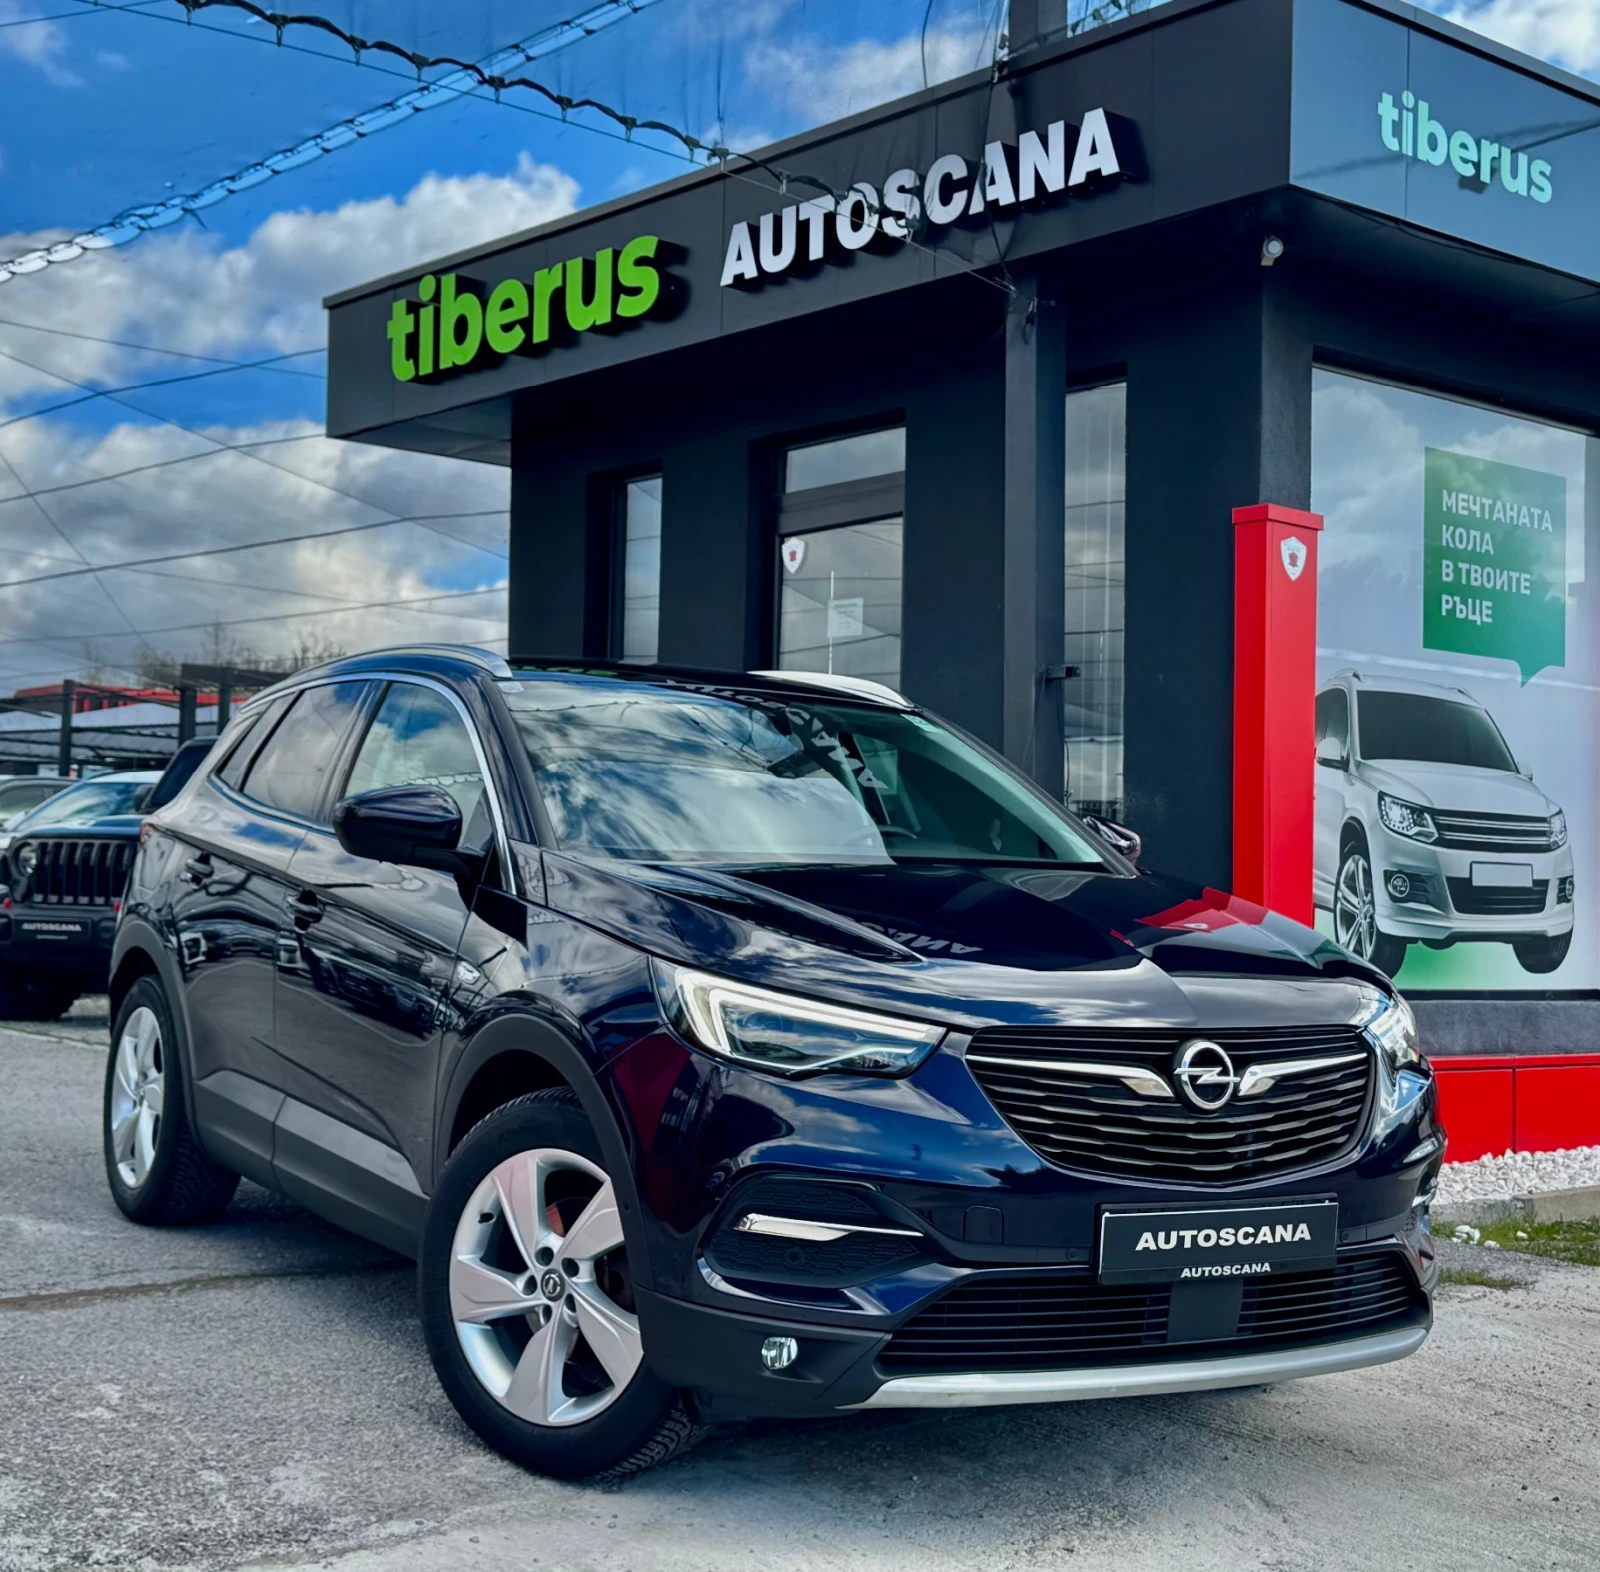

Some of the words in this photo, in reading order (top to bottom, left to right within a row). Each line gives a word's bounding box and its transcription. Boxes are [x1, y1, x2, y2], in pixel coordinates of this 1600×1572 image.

[1377, 90, 1553, 204] tiberus
[719, 107, 1120, 287] AUTOSCANA
[387, 235, 660, 382] tiberus
[1442, 489, 1553, 532] МЕЧТАНАТА
[1442, 524, 1494, 555] КОЛА
[1442, 559, 1454, 583] В
[1458, 562, 1531, 595] ТВОИТЕ
[1441, 594, 1493, 626] РЪЦЕ
[21, 922, 82, 931] AUTOSCANA
[1135, 1223, 1312, 1251] AUTOSCANA
[1180, 1262, 1271, 1278] AUTOSCANA
